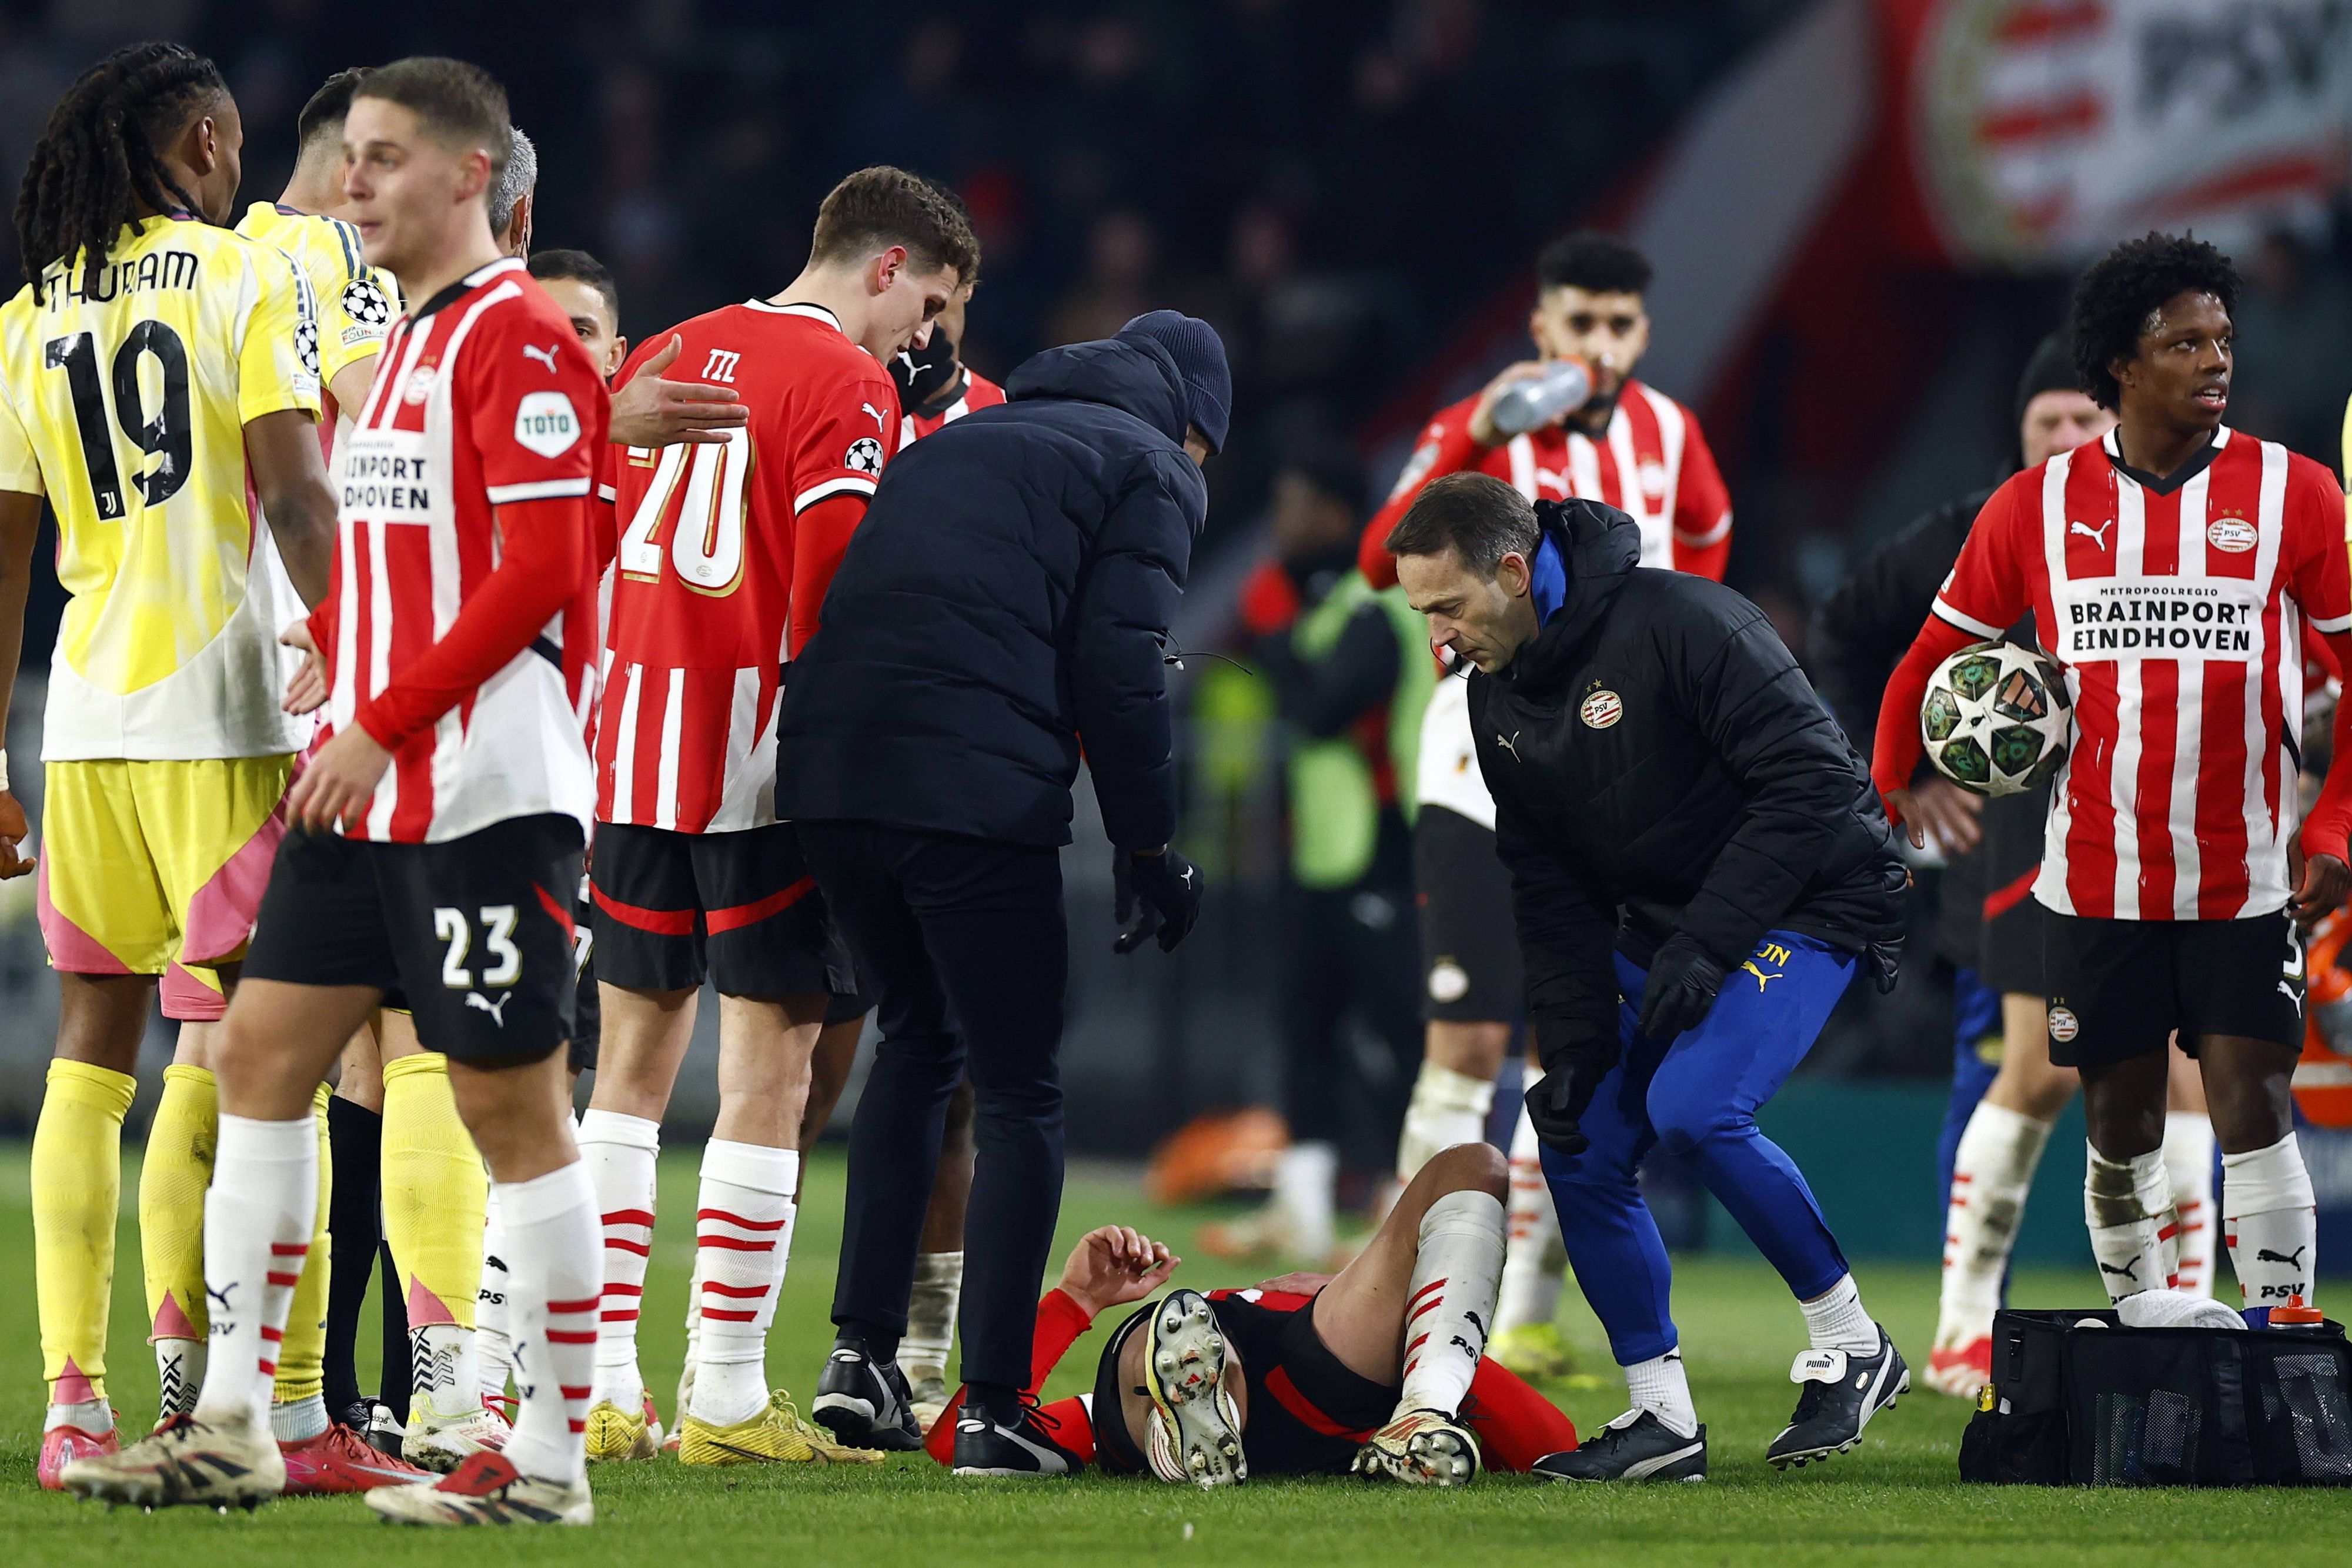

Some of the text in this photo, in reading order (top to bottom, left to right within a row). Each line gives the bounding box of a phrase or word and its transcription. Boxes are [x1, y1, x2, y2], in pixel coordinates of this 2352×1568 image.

[46, 250, 198, 313] THURAM
[701, 348, 740, 383] TIL
[46, 320, 192, 520] 19
[523, 413, 569, 434] TOTO
[620, 426, 756, 599] 20
[2100, 587, 2218, 596] METROPOOLREGIO
[2070, 600, 2251, 625] BRAINPORT
[2073, 627, 2250, 651] EINDHOVEN
[1594, 702, 1608, 714] PSV
[433, 904, 523, 989] 23
[1756, 943, 1792, 968] JN
[2261, 1283, 2305, 1298] PSV
[1806, 1360, 1830, 1369] PUMA
